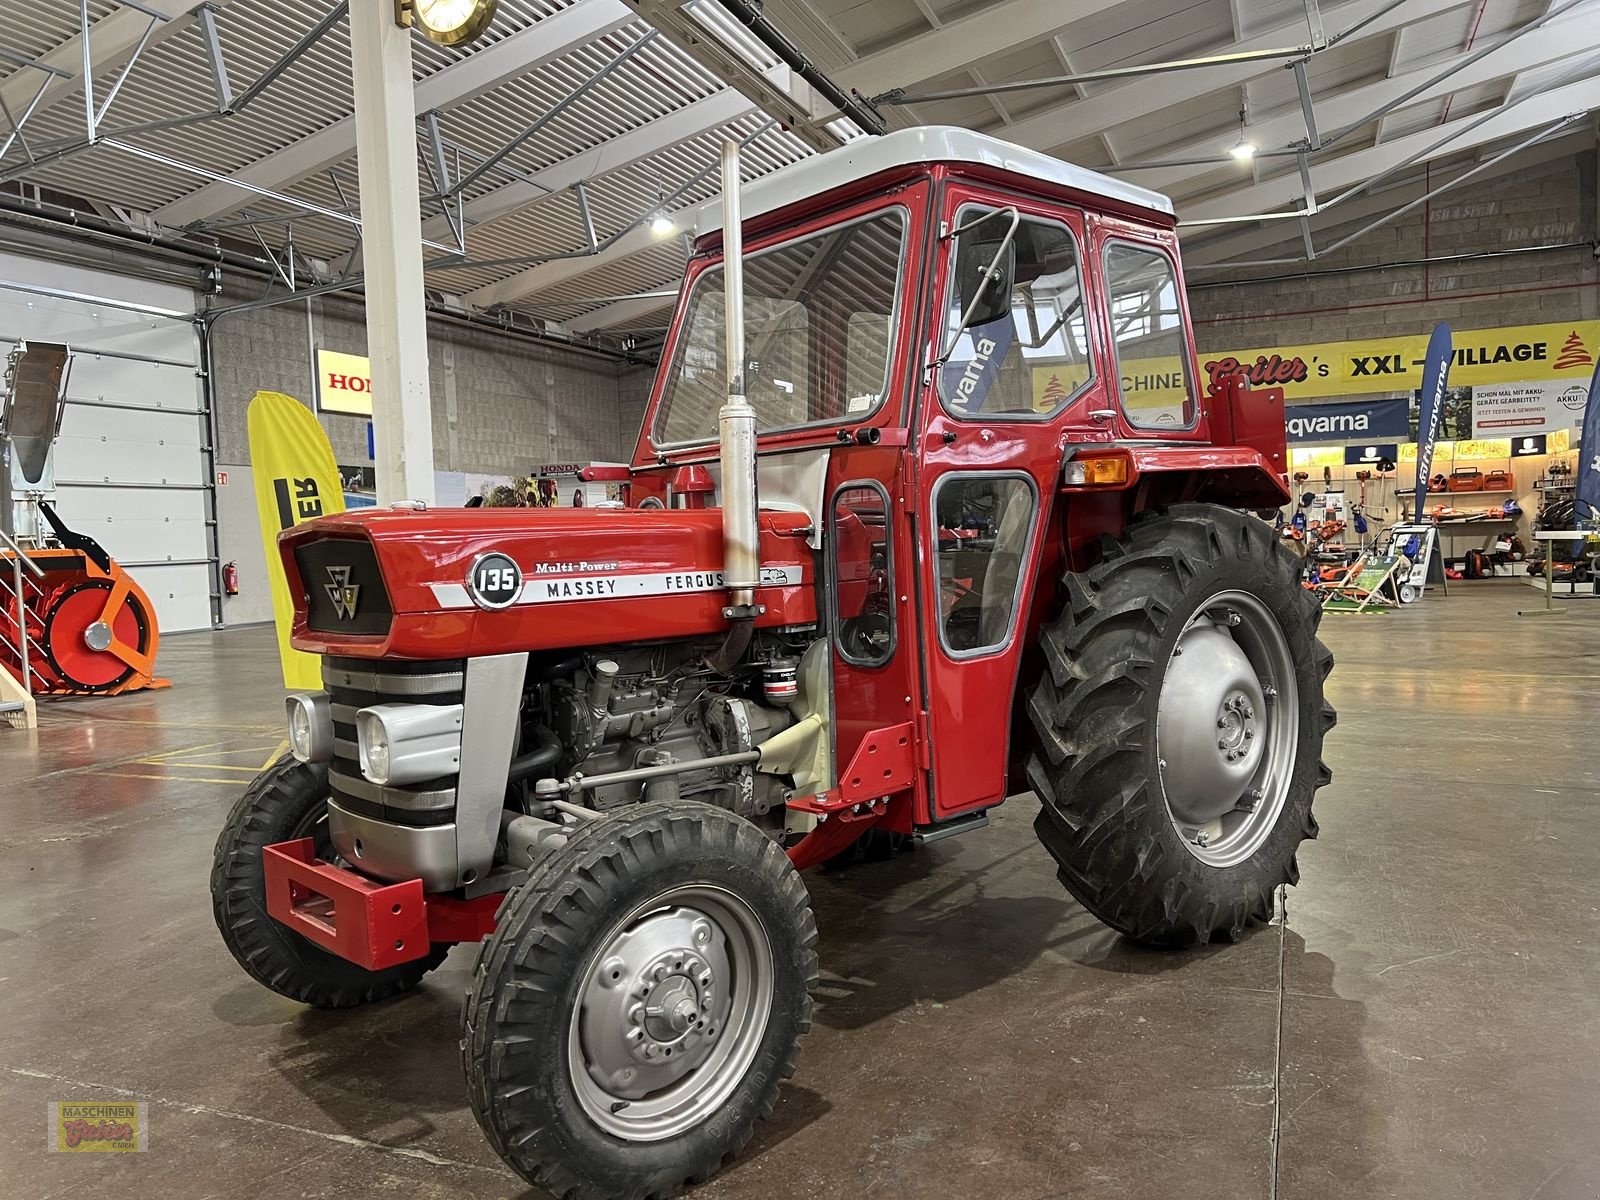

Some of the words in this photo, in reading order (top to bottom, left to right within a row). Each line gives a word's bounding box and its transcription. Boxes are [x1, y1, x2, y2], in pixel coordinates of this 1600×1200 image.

[950, 338, 998, 413] varna
[1351, 354, 1407, 377] XXL
[1476, 390, 1498, 399] SCHON
[1476, 397, 1500, 406] GERÄTE
[1500, 396, 1540, 405] GEARBEITET?
[1557, 394, 1586, 403] AKKUTE
[1423, 360, 1448, 464] Husqvarna
[1285, 412, 1369, 437] qvarna
[540, 464, 580, 473] HONDA
[535, 561, 617, 574] Multi-Power
[479, 568, 515, 592] 135
[547, 579, 616, 598] MASSEY
[665, 573, 724, 590] FERGUS
